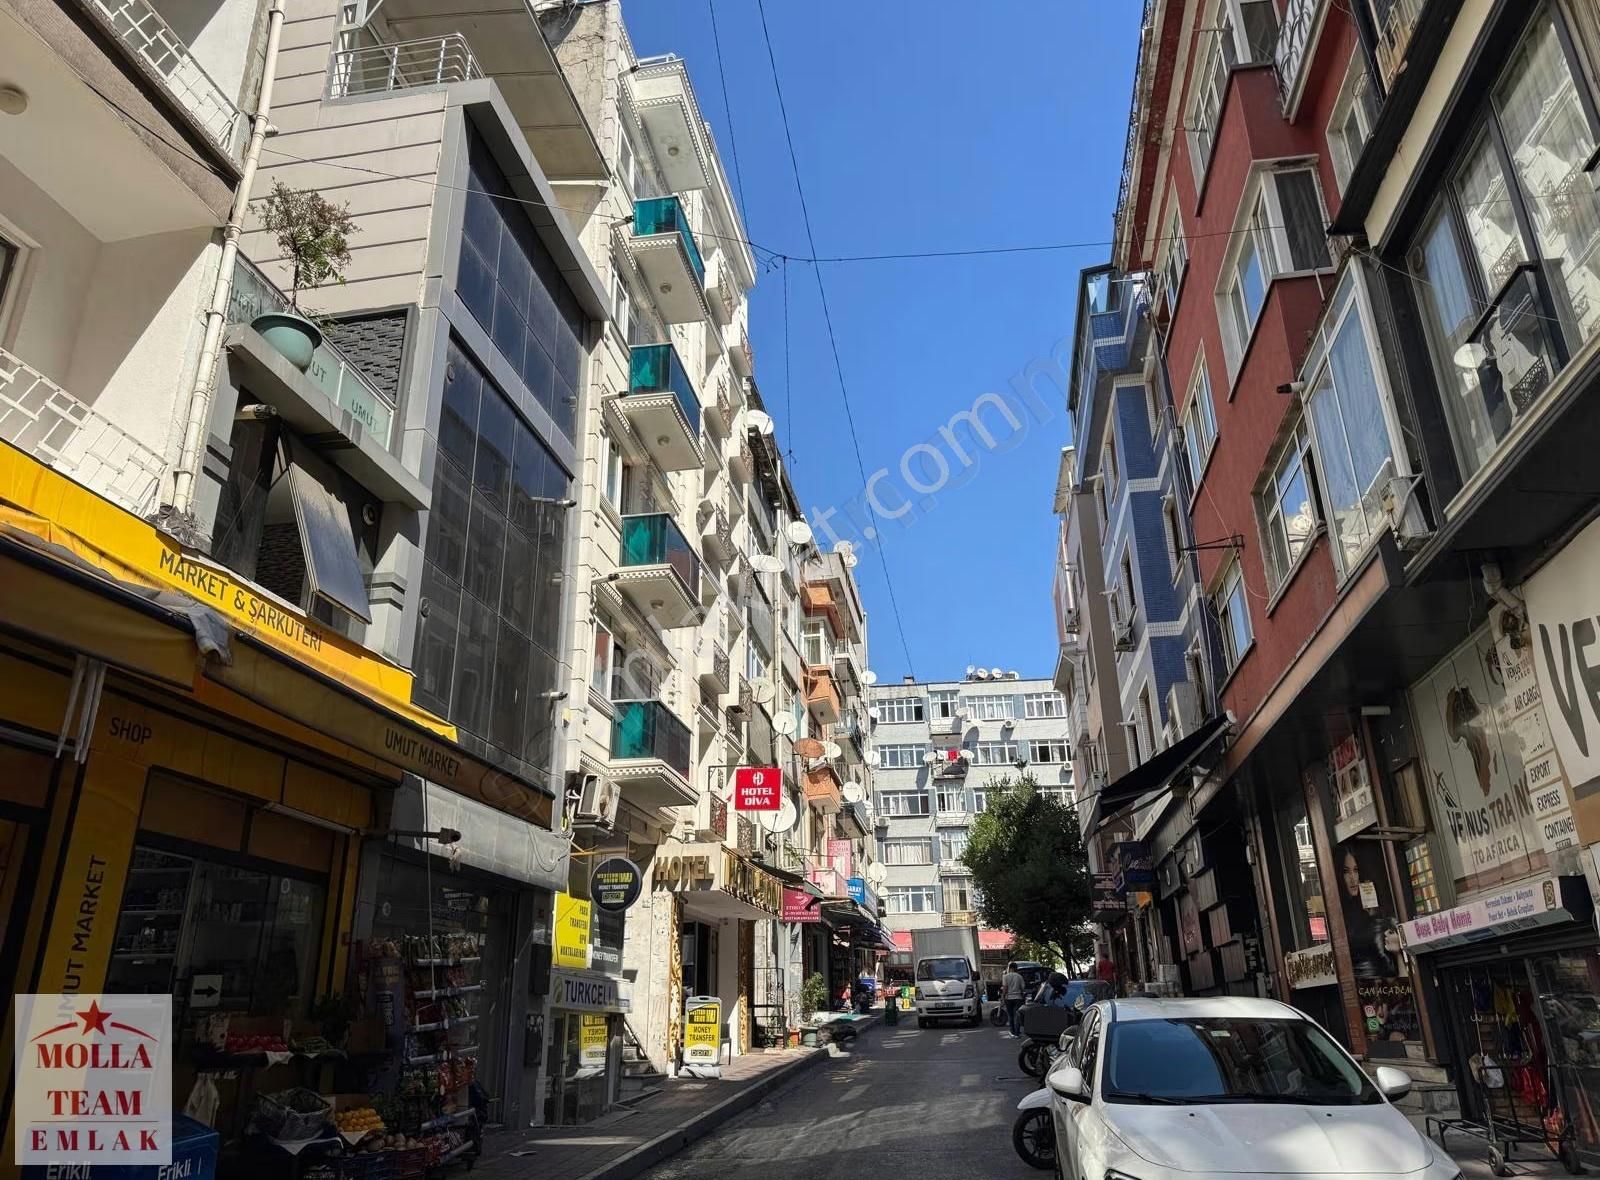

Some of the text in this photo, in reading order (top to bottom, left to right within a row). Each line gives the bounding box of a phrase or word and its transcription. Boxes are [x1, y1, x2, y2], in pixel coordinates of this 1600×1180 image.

[351, 399, 378, 432] UMUT
[159, 548, 323, 653] MARKET & ŞARKUTERİ
[1538, 614, 1600, 758] VE
[109, 716, 152, 744] SHOP
[385, 727, 461, 777] UMUT MARKET
[1529, 760, 1551, 784] EXPORT
[741, 787, 775, 796] HOTEL
[744, 795, 770, 806] DİVA
[1537, 788, 1561, 812] EXPRESS
[1446, 807, 1490, 845] VENUS
[1474, 834, 1521, 866] TO AFRICA
[654, 855, 715, 882] HOTEL
[71, 854, 108, 952] MARKET
[1431, 915, 1450, 936] Baby
[689, 1034, 716, 1042] TRANSFER
[157, 1158, 191, 1180] Erikli
